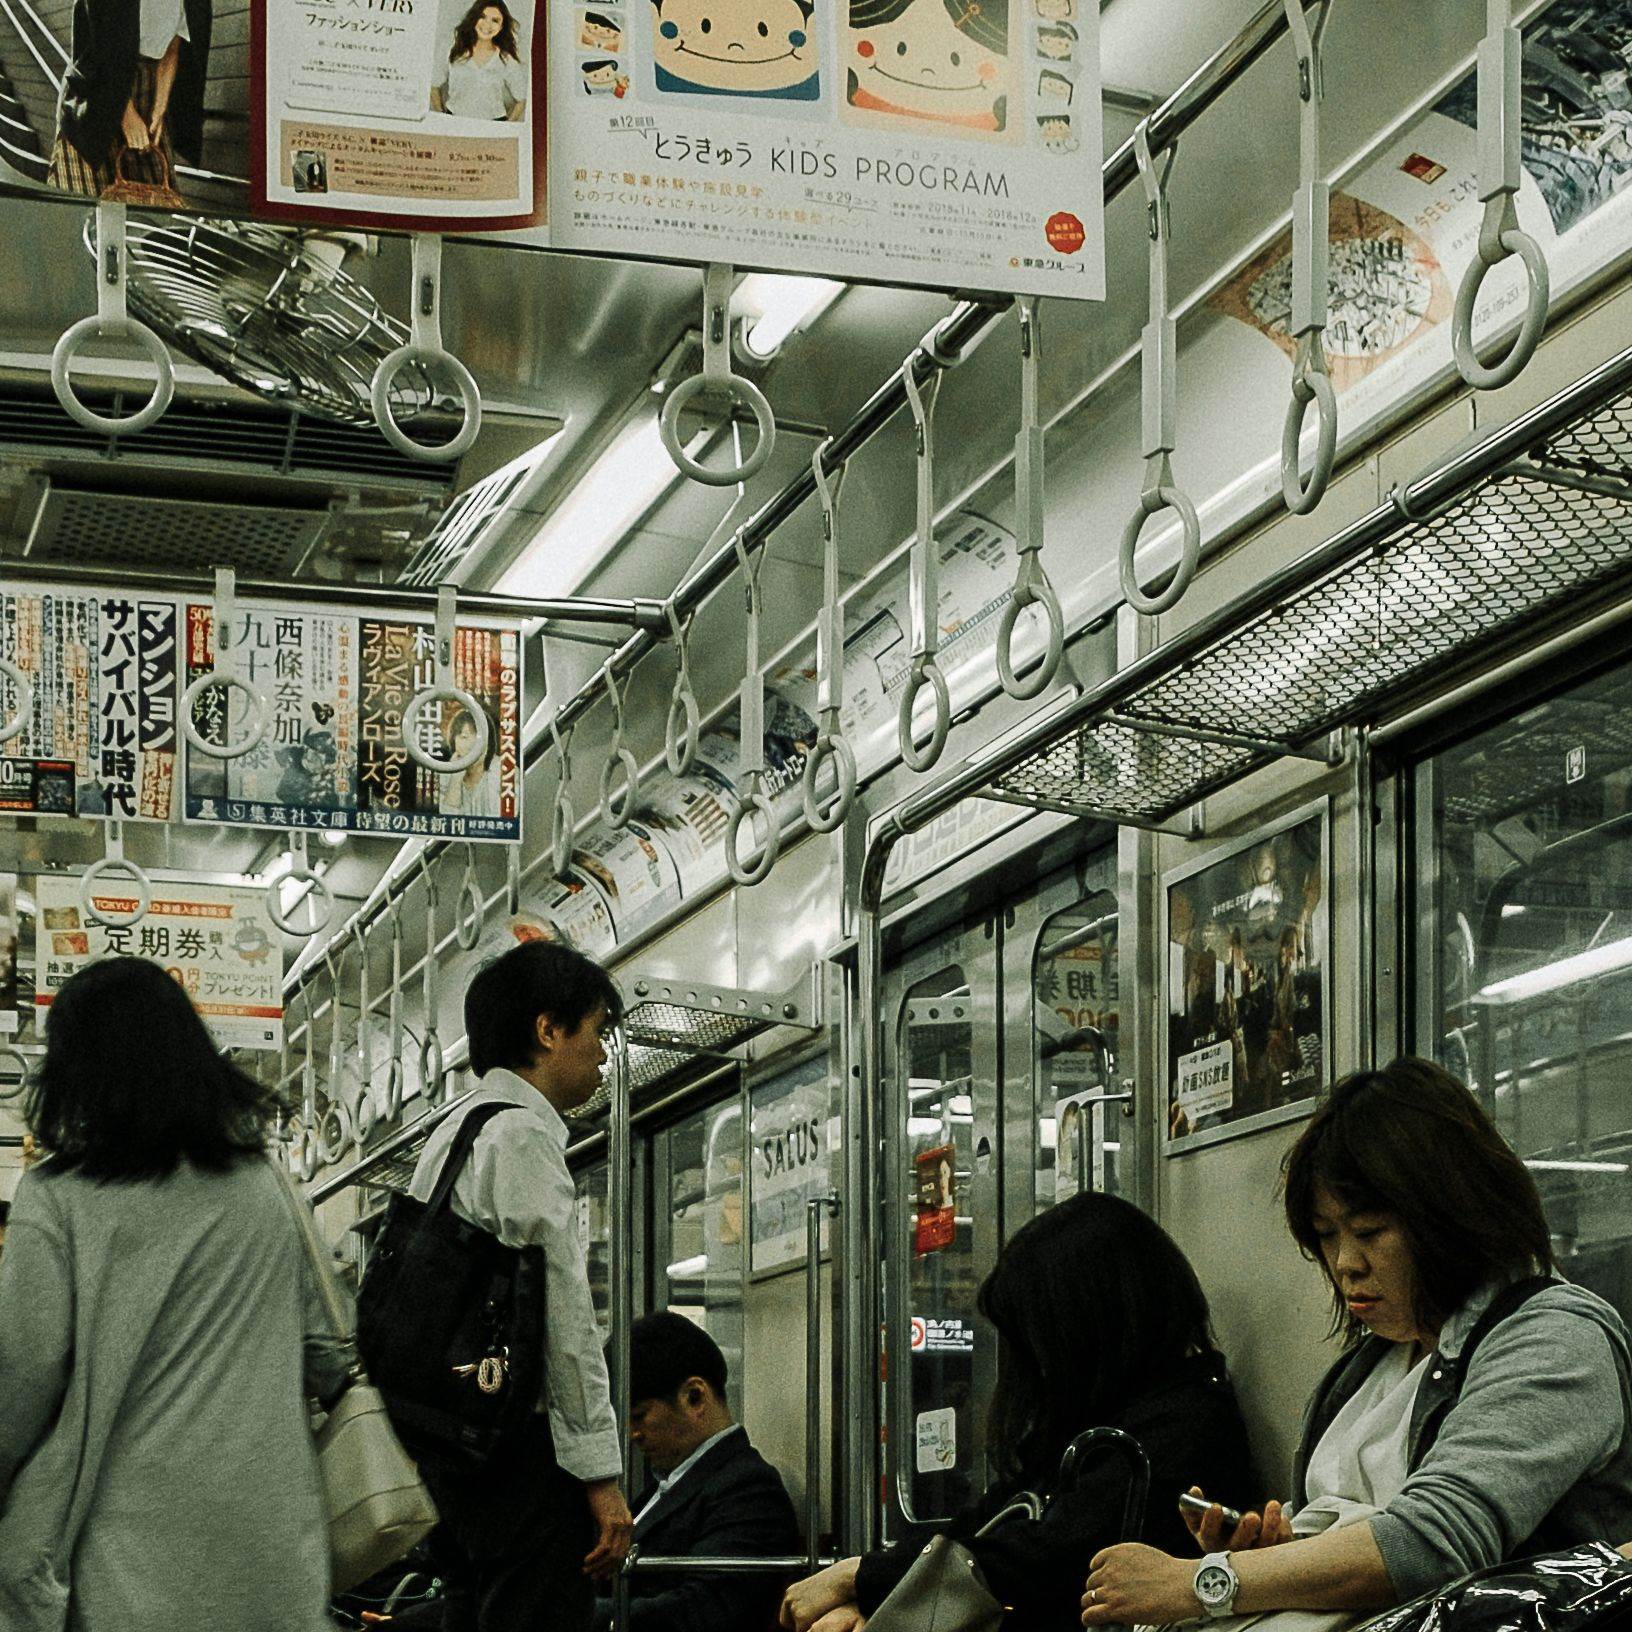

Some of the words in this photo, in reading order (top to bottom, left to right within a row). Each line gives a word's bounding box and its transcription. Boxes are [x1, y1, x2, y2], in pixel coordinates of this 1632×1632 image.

[306, 13, 405, 36] ファッションショー
[655, 132, 752, 167] とうきゅう
[771, 147, 837, 178] KIDS
[856, 157, 1009, 198] PROGRAM
[385, 625, 409, 660] La
[101, 599, 137, 817] サバイバル時代
[141, 603, 175, 751] マンション
[273, 616, 304, 745] 西條奈加
[362, 623, 383, 782] ラヴィアンローズ
[384, 709, 402, 740] en
[384, 748, 408, 809] Rose
[249, 803, 349, 829] 集英社文庫
[355, 812, 466, 836] 待望の最新刊
[103, 925, 207, 959] 定期券
[763, 1117, 819, 1180] SALUS
